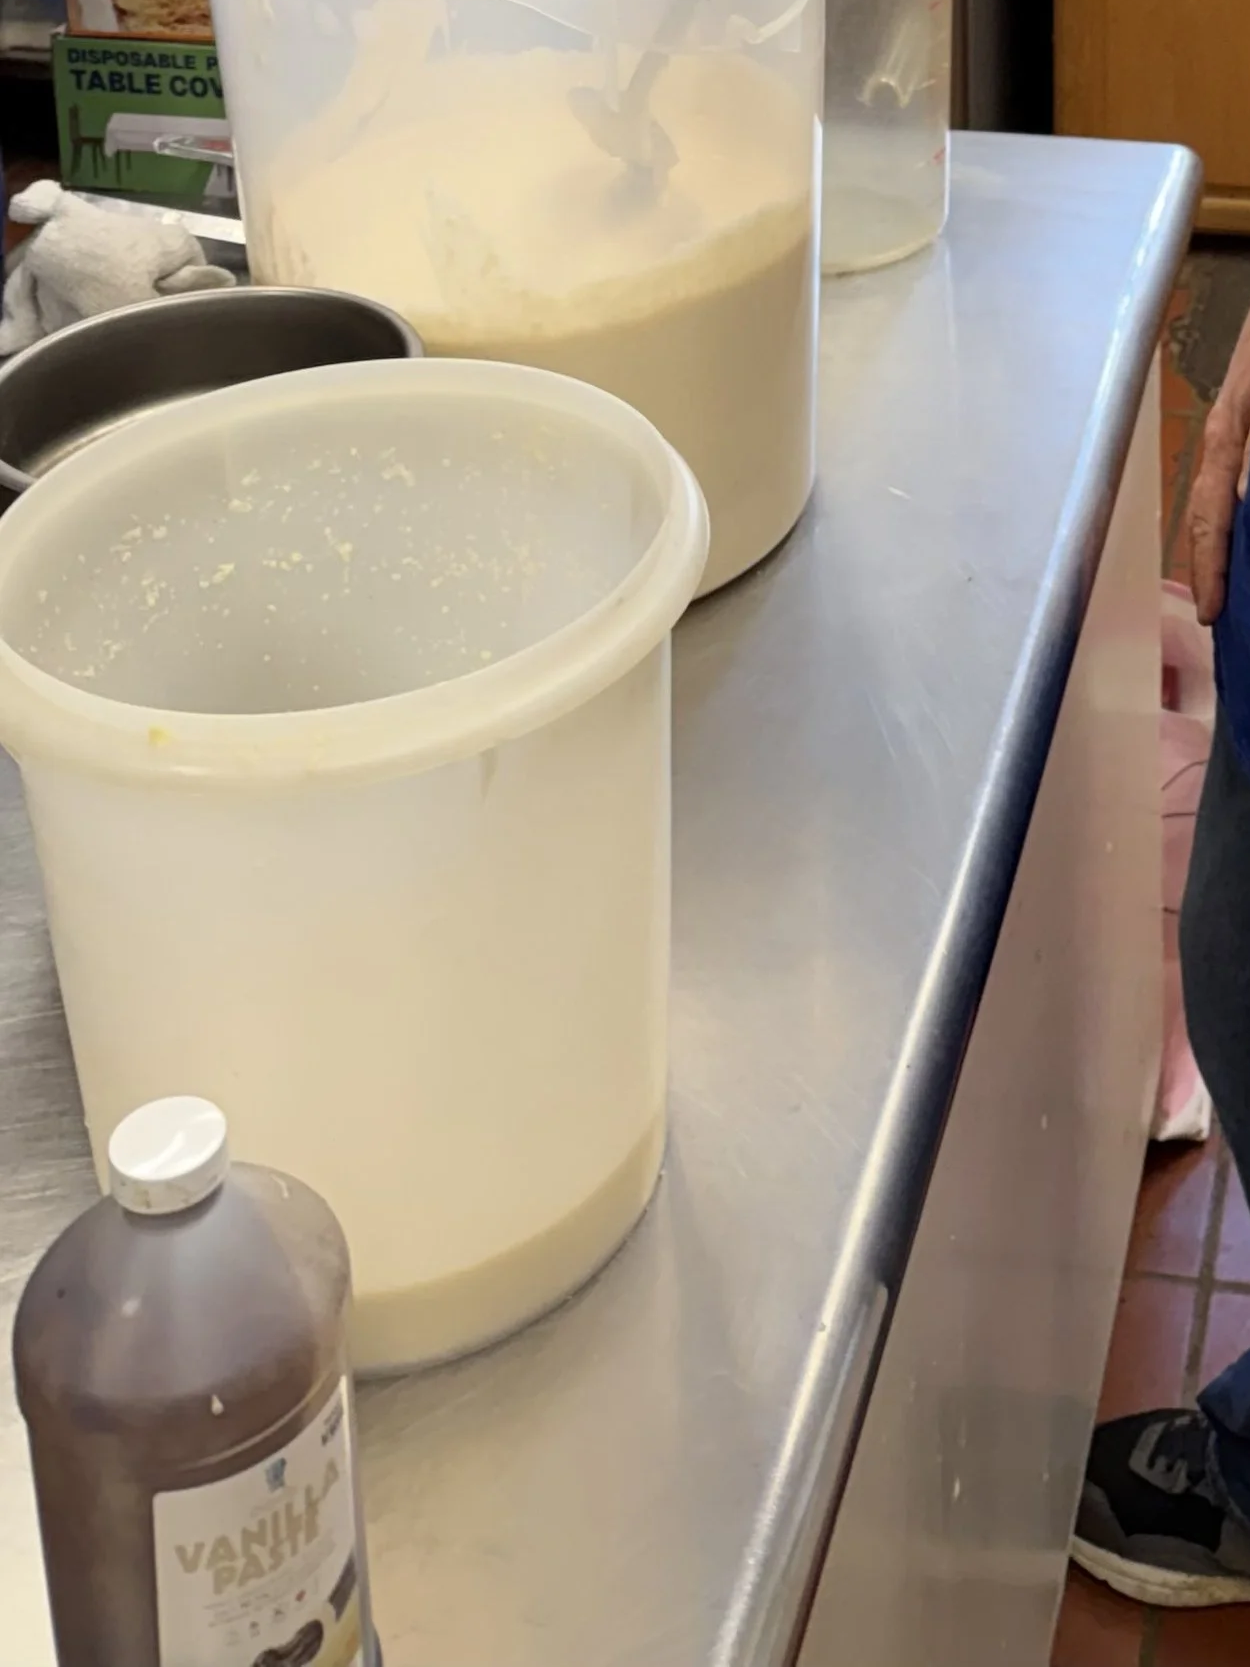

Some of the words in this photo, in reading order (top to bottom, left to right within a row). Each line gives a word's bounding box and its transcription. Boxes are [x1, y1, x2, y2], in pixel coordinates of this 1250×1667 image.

[67, 48, 196, 70] DISPOSABLE
[69, 69, 162, 95] TABLE
[174, 1457, 339, 1575] VANILLA
[212, 1512, 319, 1595] PASTE
